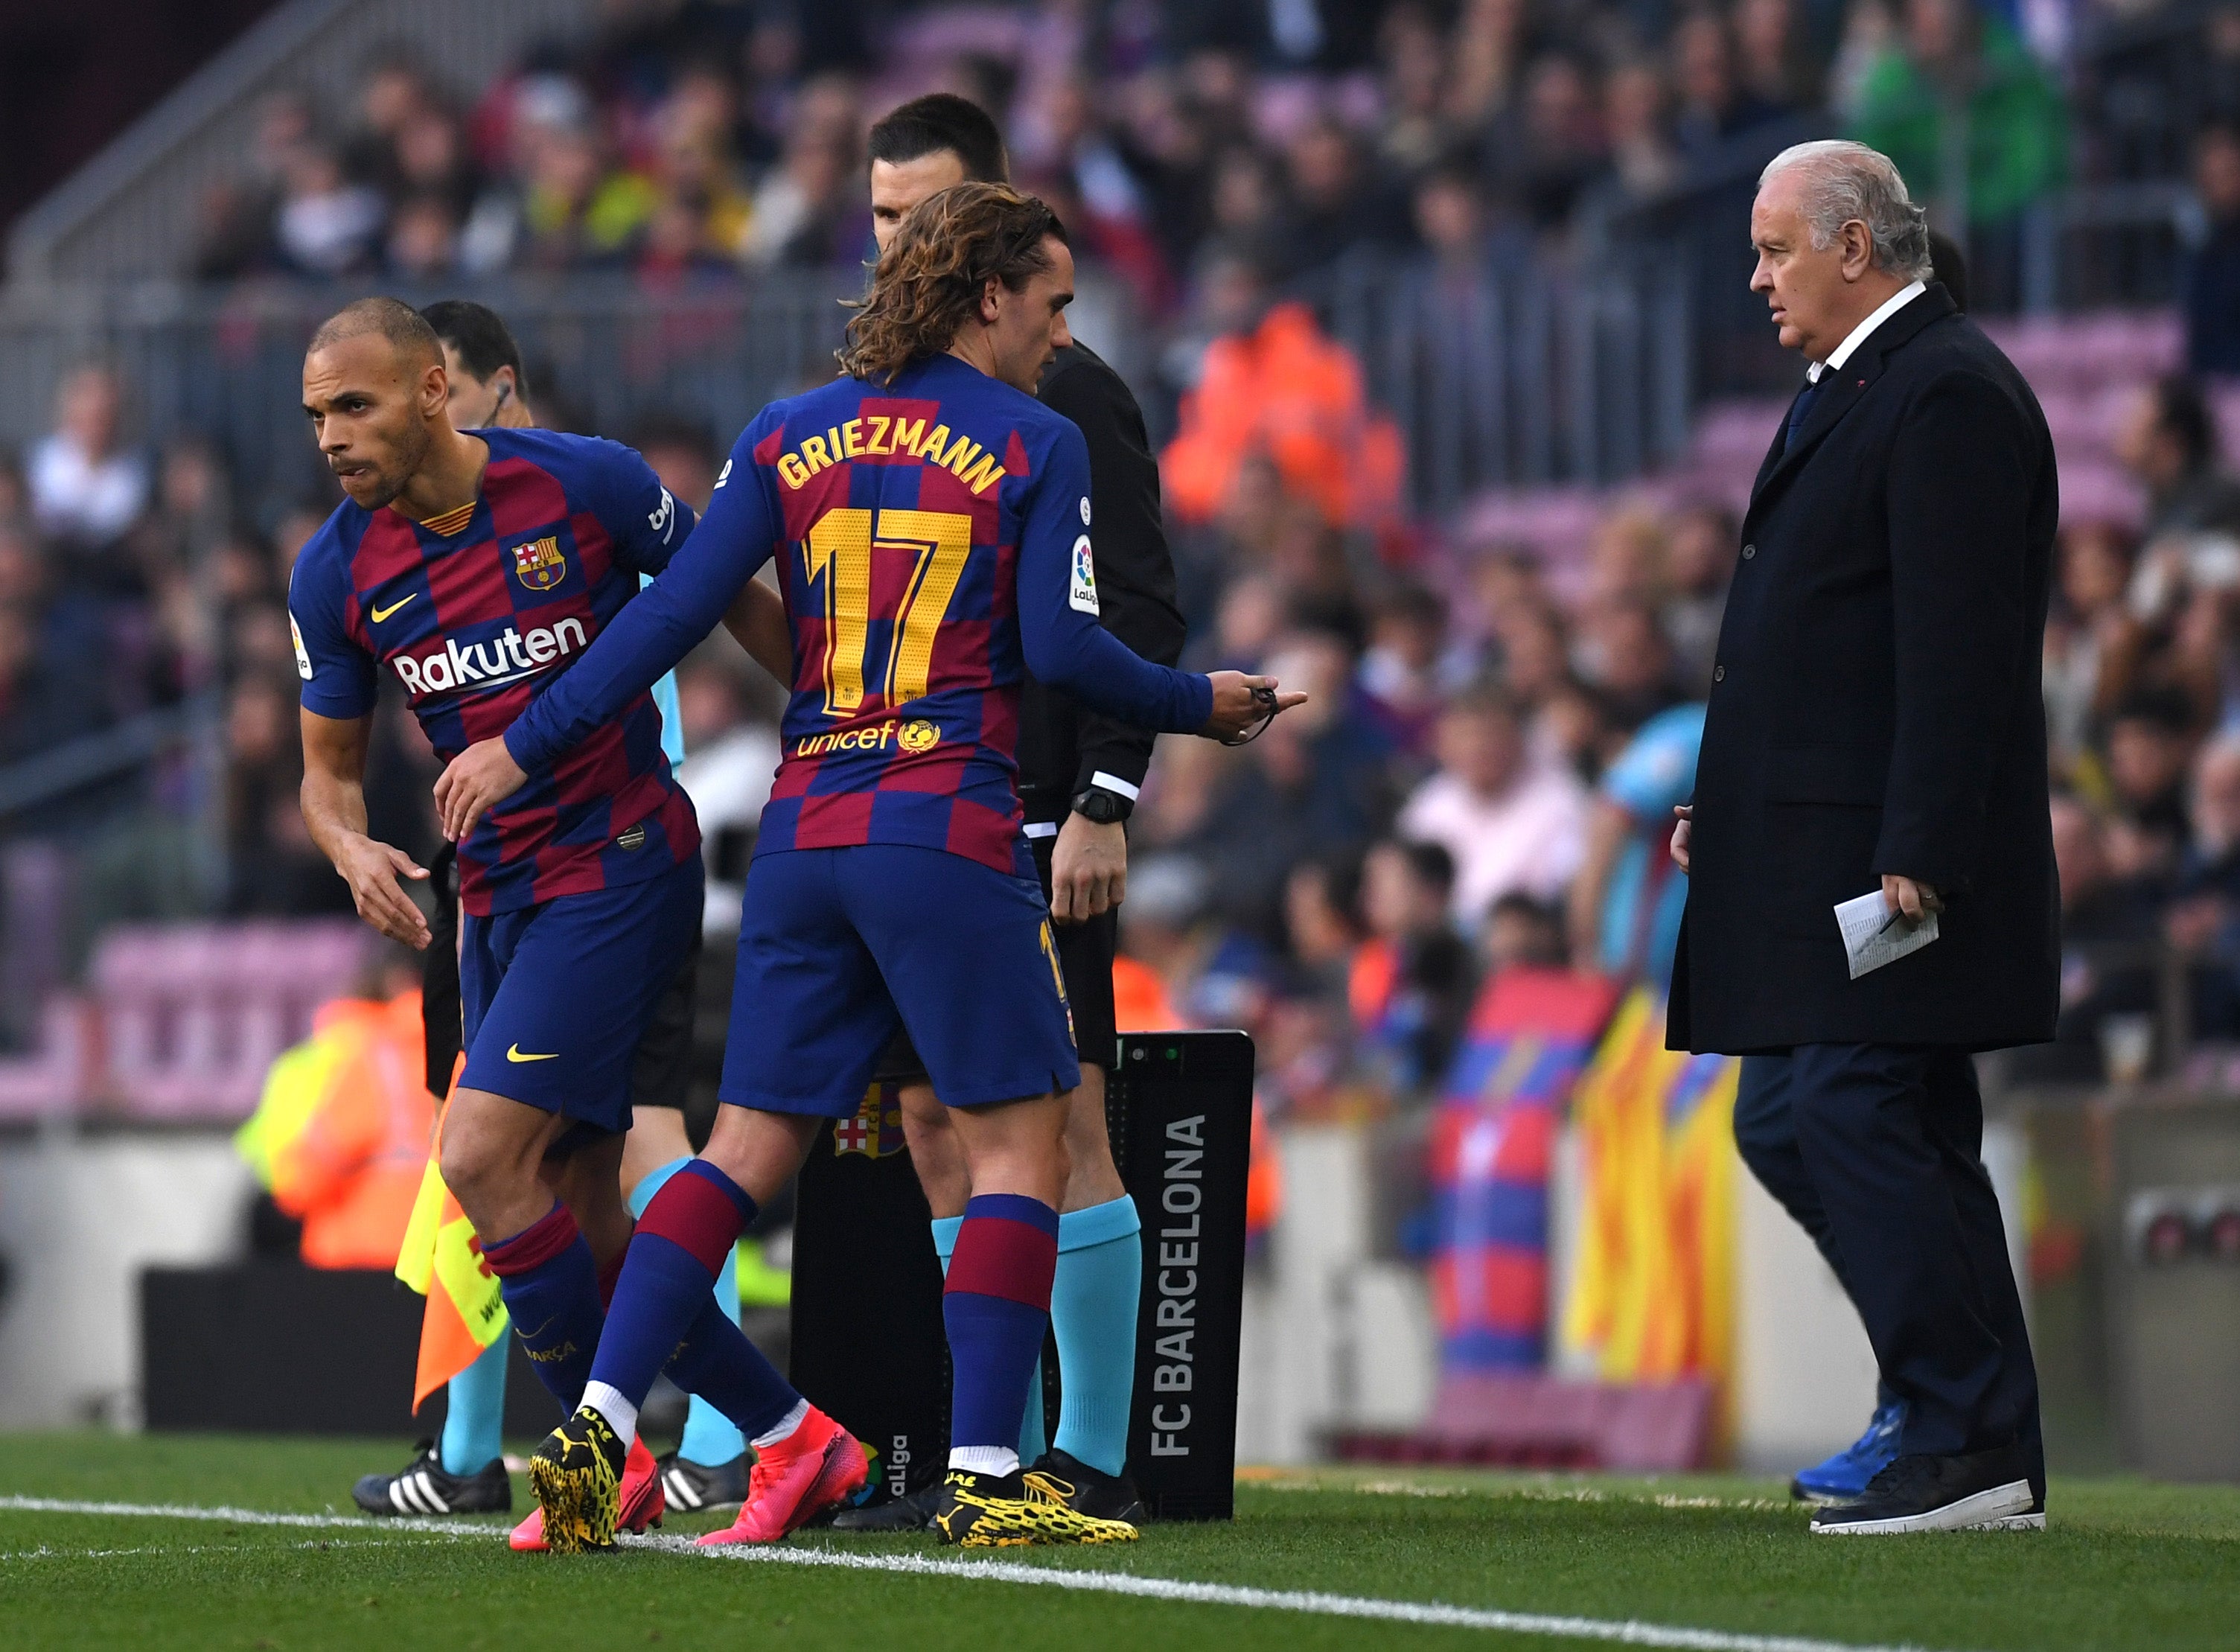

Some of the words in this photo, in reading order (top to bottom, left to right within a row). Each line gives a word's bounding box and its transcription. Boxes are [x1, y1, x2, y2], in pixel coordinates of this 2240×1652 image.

[777, 416, 1006, 495] GRIEZMANN
[801, 508, 972, 718] 17
[393, 617, 587, 694] Rakuten
[797, 719, 896, 757] unicef
[1152, 1114, 1206, 1393] BARCELONA
[887, 1435, 911, 1498] aLiga
[1150, 1403, 1191, 1456] FC
